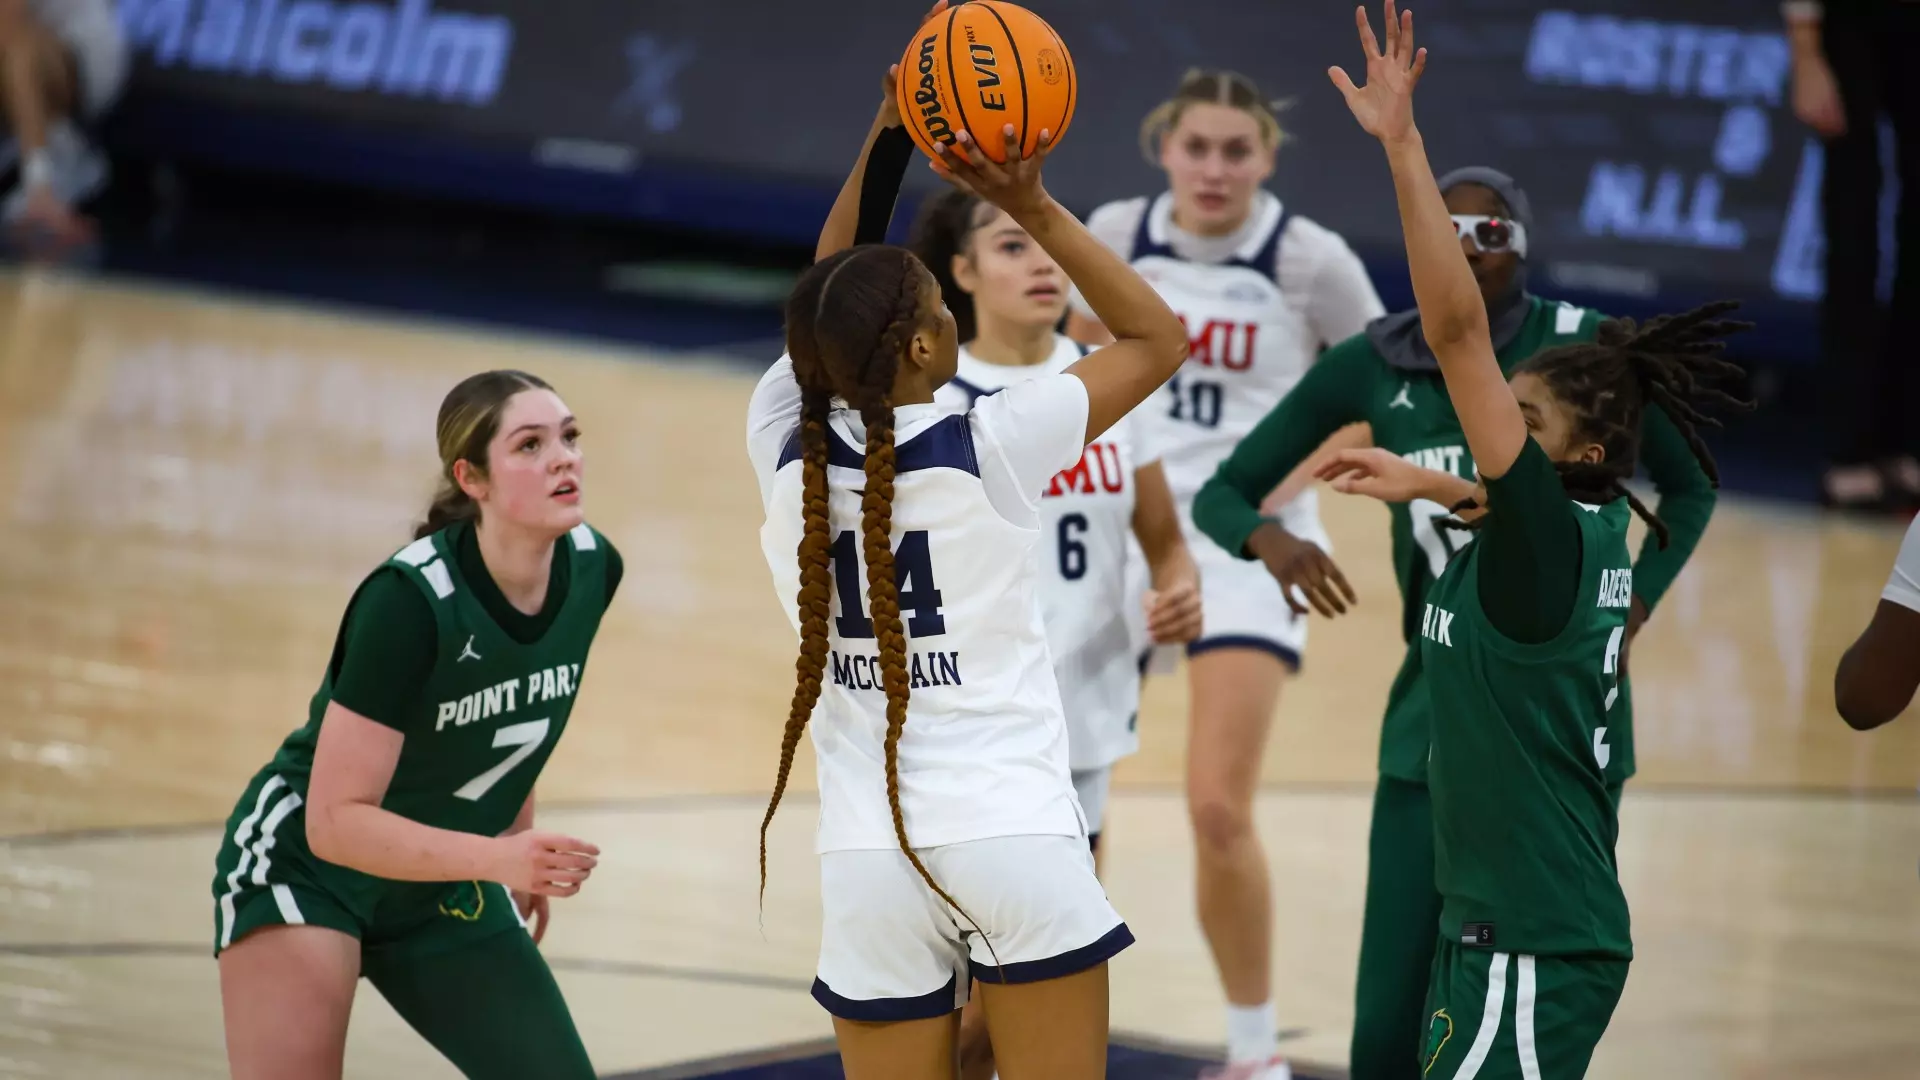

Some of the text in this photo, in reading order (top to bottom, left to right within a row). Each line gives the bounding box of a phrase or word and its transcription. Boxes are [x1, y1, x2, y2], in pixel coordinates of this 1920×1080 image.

[964, 25, 976, 43] NXT
[915, 34, 957, 146] Wilson
[969, 43, 1006, 111] EVO
[1176, 313, 1258, 374] MU
[1042, 443, 1123, 497] MU
[1058, 512, 1089, 580] 6
[827, 530, 946, 638] 14
[831, 650, 962, 691] MCCAIN
[435, 678, 519, 731] POINT
[452, 717, 551, 801] 7
